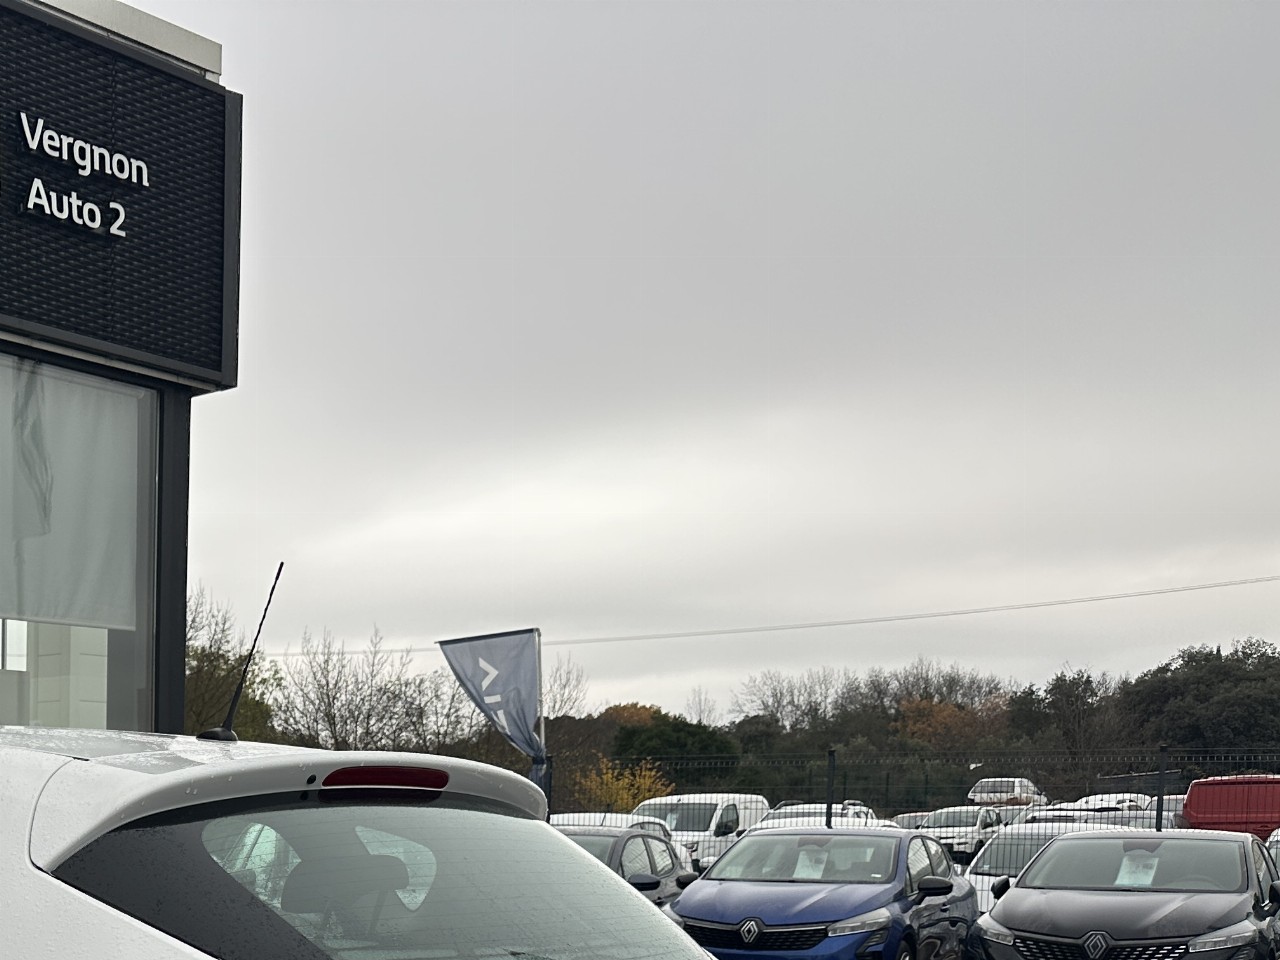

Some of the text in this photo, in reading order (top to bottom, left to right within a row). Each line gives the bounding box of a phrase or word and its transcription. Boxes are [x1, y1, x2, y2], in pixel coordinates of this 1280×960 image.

[20, 111, 150, 187] Vergnon
[27, 177, 127, 238] Auto 2
